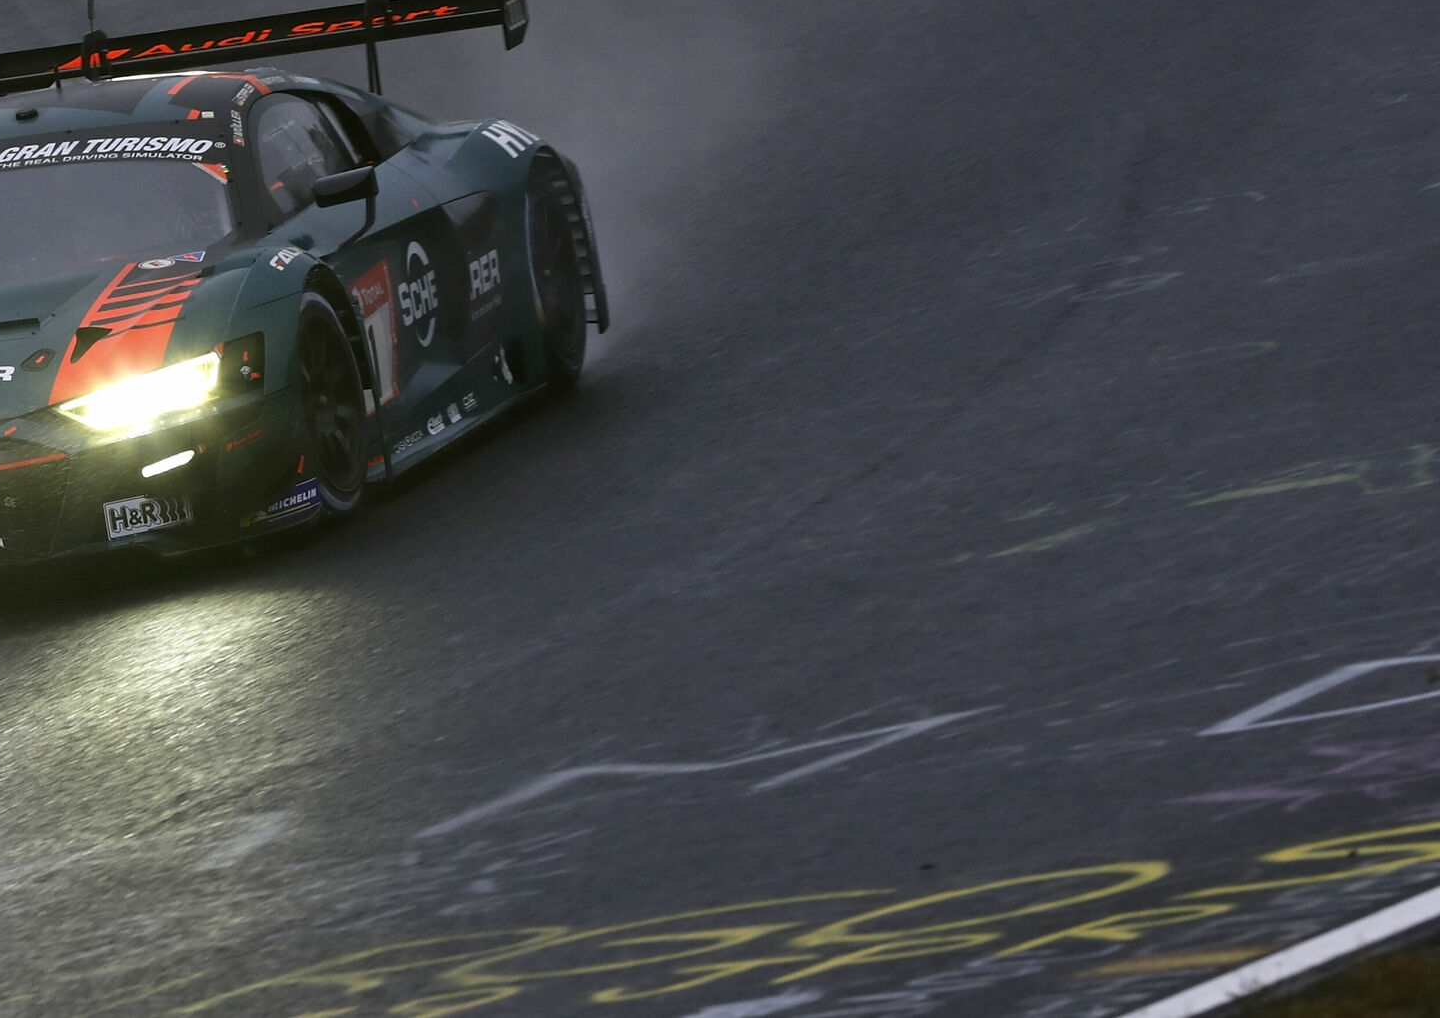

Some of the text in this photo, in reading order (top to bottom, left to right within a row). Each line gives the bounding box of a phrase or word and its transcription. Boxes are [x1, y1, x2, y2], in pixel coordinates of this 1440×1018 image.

[132, 5, 459, 59] Audi Sport
[81, 136, 213, 154] TURISMO
[24, 157, 59, 167] REAL
[62, 152, 119, 162] DRIVING
[122, 151, 203, 161] SIMULATOR
[267, 487, 317, 513] MICHELIN
